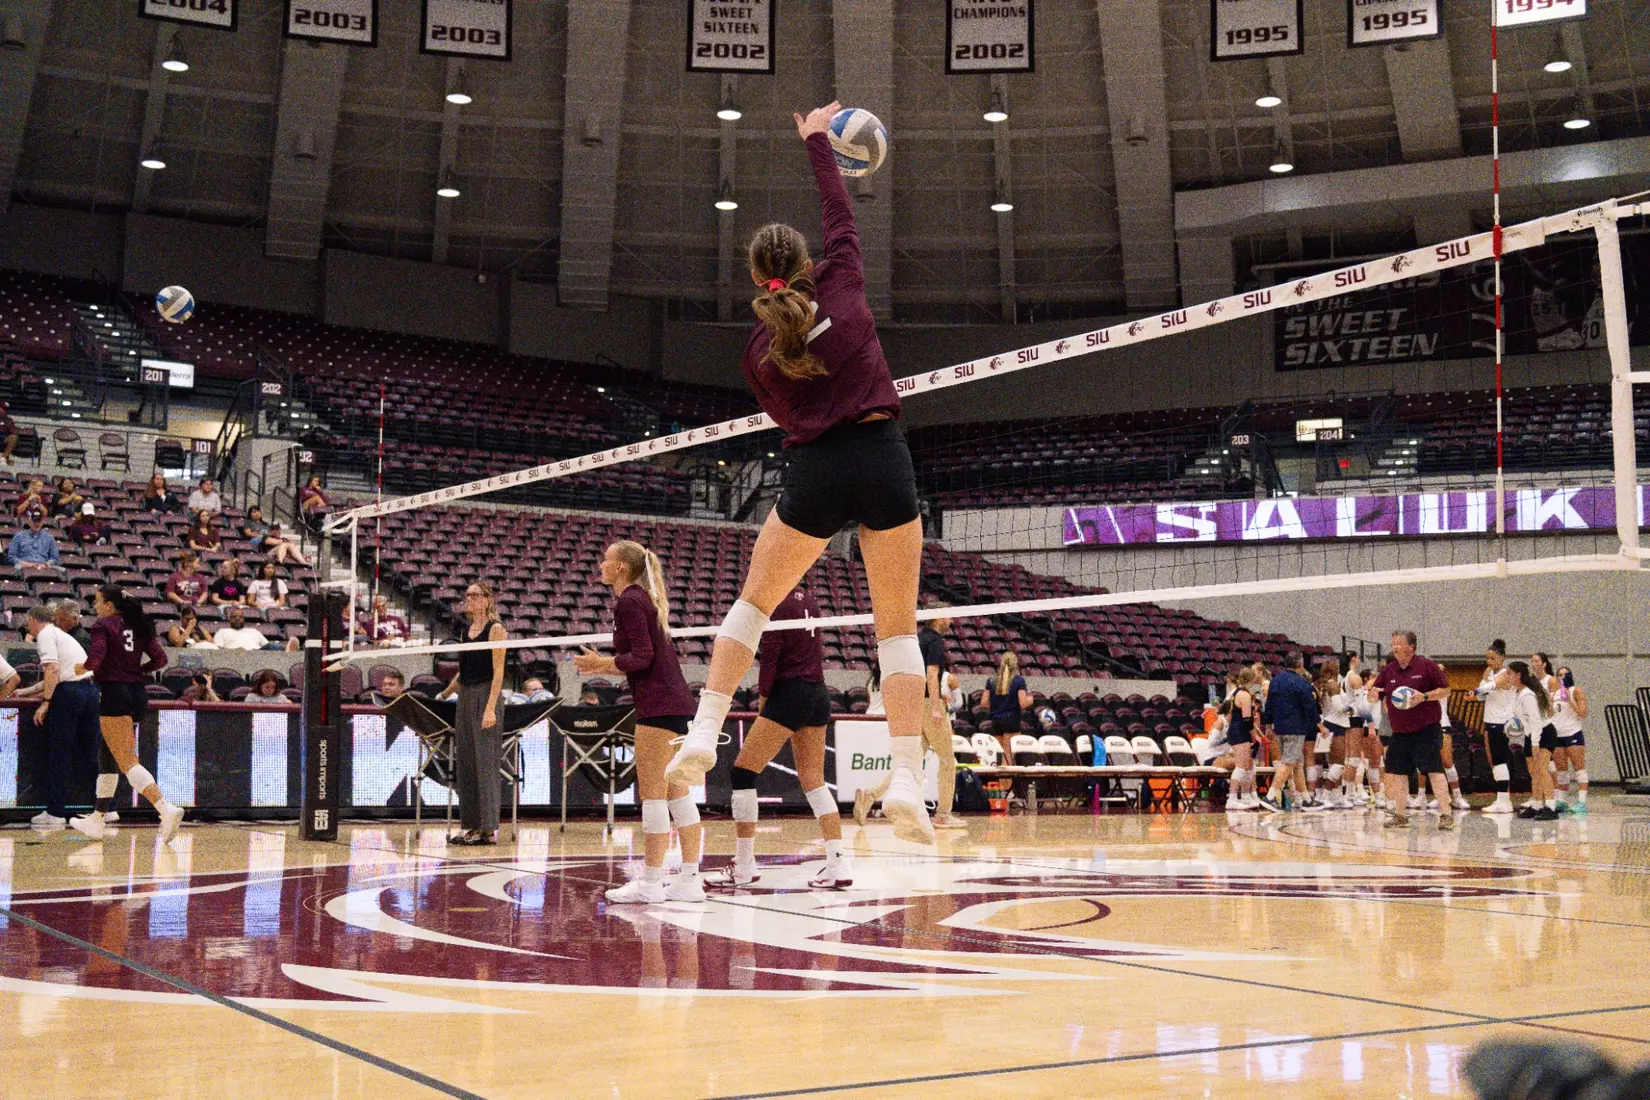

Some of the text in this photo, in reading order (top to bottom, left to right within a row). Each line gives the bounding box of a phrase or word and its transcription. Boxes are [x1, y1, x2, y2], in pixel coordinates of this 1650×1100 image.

[150, 0, 227, 14] 004
[710, 7, 752, 18] SWEET
[954, 7, 1026, 19] CHAMPIONS
[295, 8, 367, 30] 2003
[1362, 9, 1427, 31] 1995
[431, 24, 501, 45] 2003
[704, 21, 759, 34] SIXTEEN
[1226, 25, 1289, 45] 1995
[697, 43, 765, 59] 2002
[955, 43, 1024, 59] 2002
[1435, 240, 1471, 263] SIU
[1334, 266, 1366, 288] SIU
[1243, 290, 1272, 309] SIU
[1161, 310, 1187, 329] SIU
[1283, 308, 1408, 339] SWEET
[1085, 330, 1110, 348] SIU
[1017, 347, 1039, 364] SIU
[1283, 333, 1440, 366] SIXTEEN
[144, 370, 163, 382] 201
[954, 363, 974, 379] SIU
[261, 382, 282, 395] 202
[896, 378, 915, 393] SIU
[747, 415, 763, 427] SIU
[704, 426, 719, 437] SIU
[1231, 434, 1250, 445] 203
[1320, 430, 1338, 440] 204
[195, 441, 211, 453] 101
[627, 444, 640, 455] SIU
[664, 436, 679, 447] SIU
[559, 461, 571, 471] SIU
[591, 453, 605, 463] SIU
[123, 629, 134, 651] 3
[319, 739, 327, 766] sports
[319, 767, 327, 800] imports
